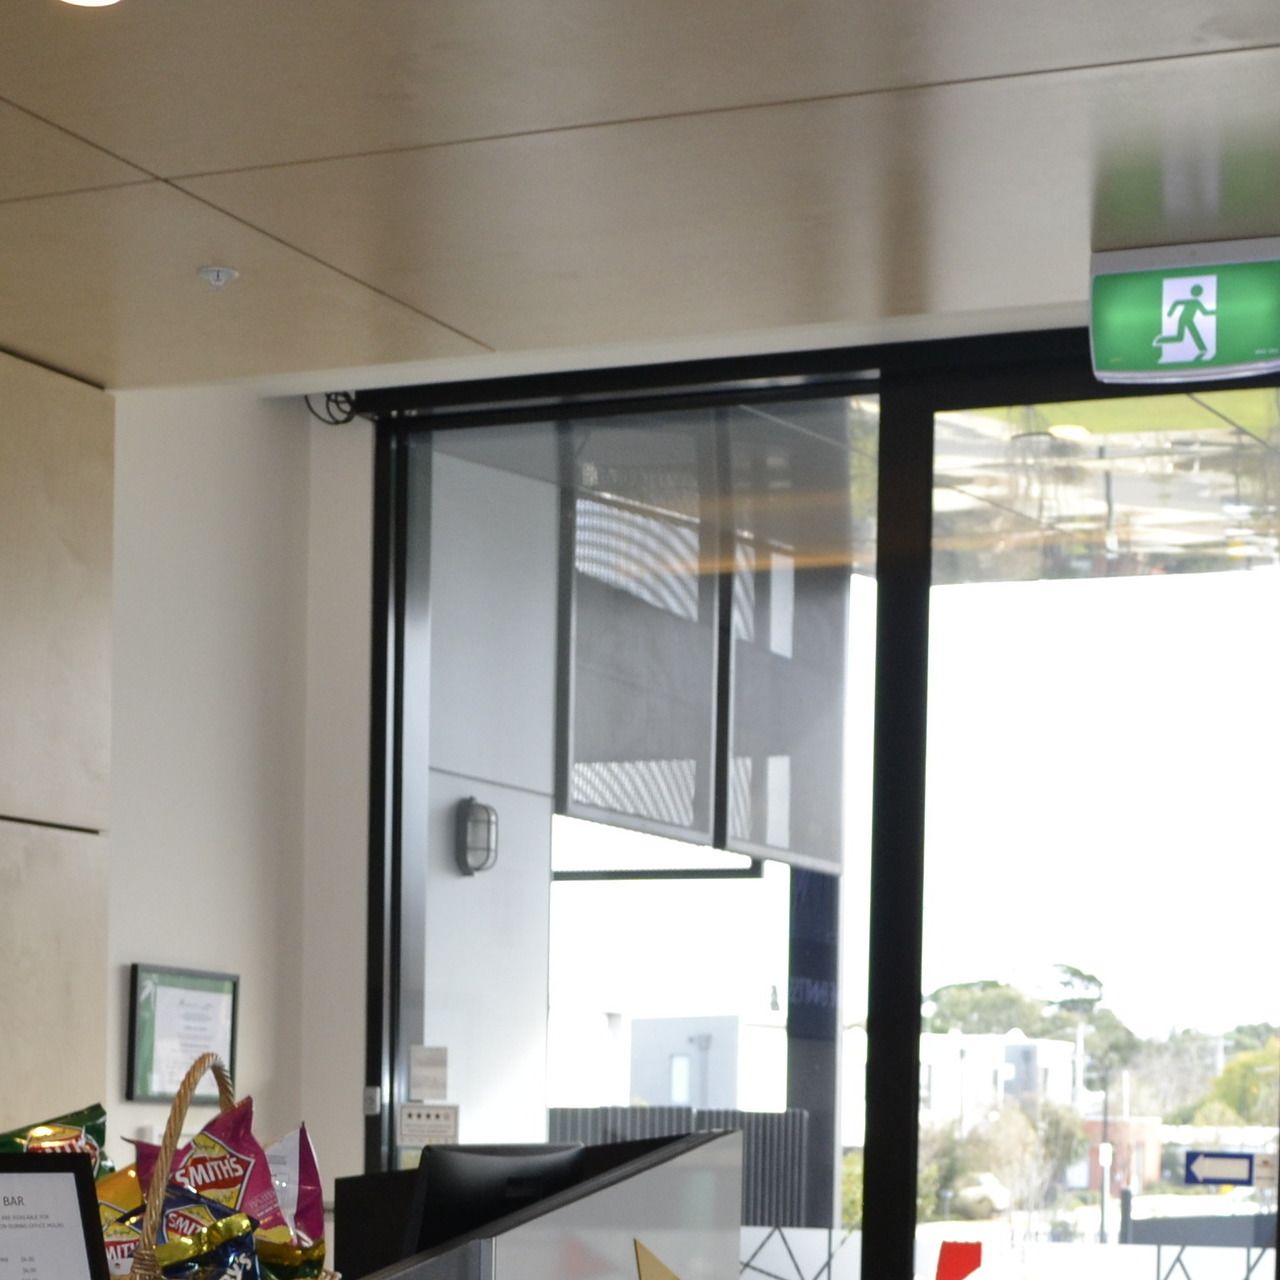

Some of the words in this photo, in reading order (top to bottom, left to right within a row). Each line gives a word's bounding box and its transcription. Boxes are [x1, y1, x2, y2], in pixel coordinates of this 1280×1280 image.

[175, 1154, 244, 1188] SMITH'S
[3, 1196, 24, 1207] BAR
[168, 1212, 203, 1235] SMIT
